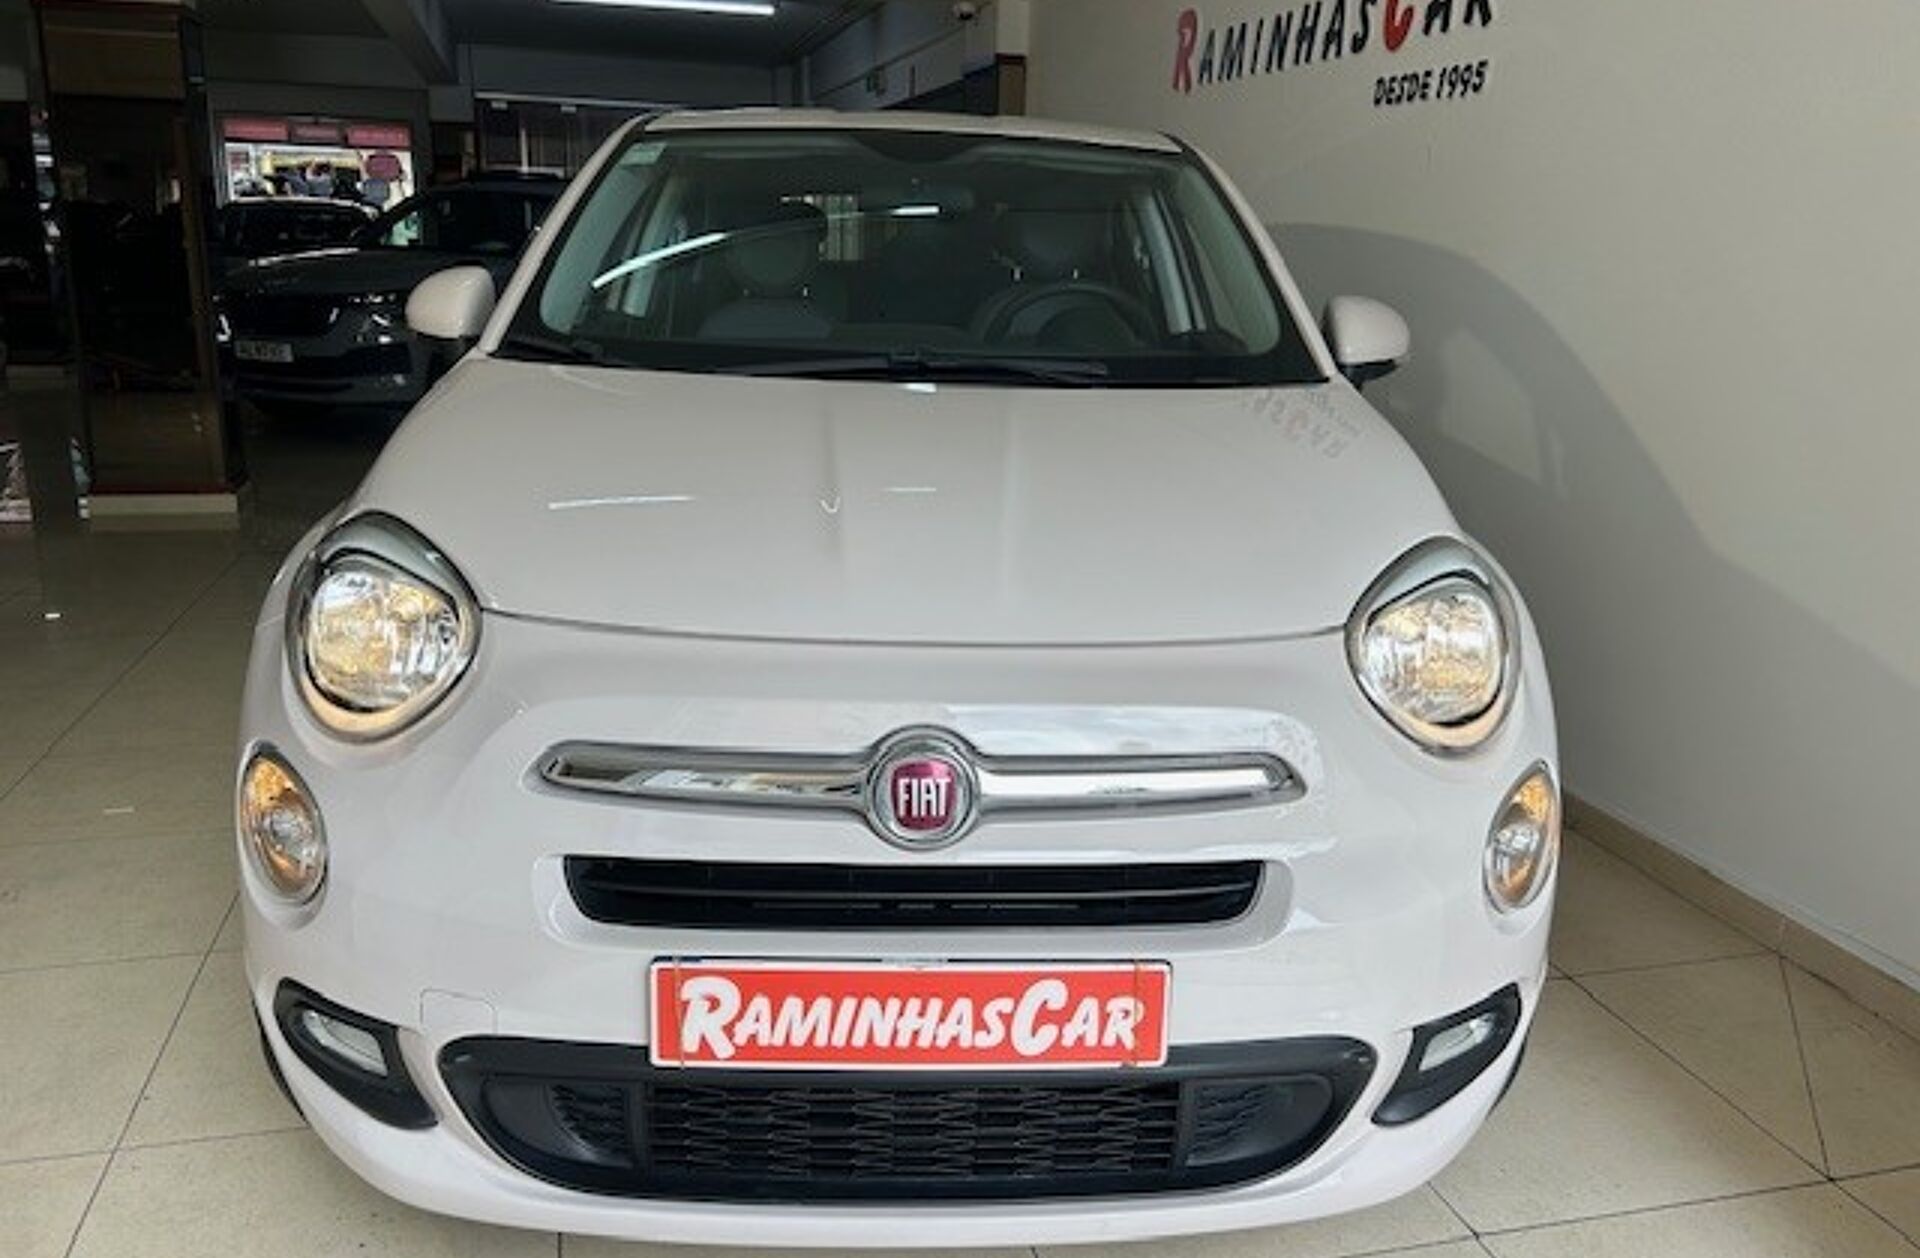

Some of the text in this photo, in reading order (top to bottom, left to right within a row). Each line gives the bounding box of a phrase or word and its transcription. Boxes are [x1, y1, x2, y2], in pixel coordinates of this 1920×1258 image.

[1373, 60, 1489, 107] DESDE 1995
[897, 777, 951, 817] FIAT
